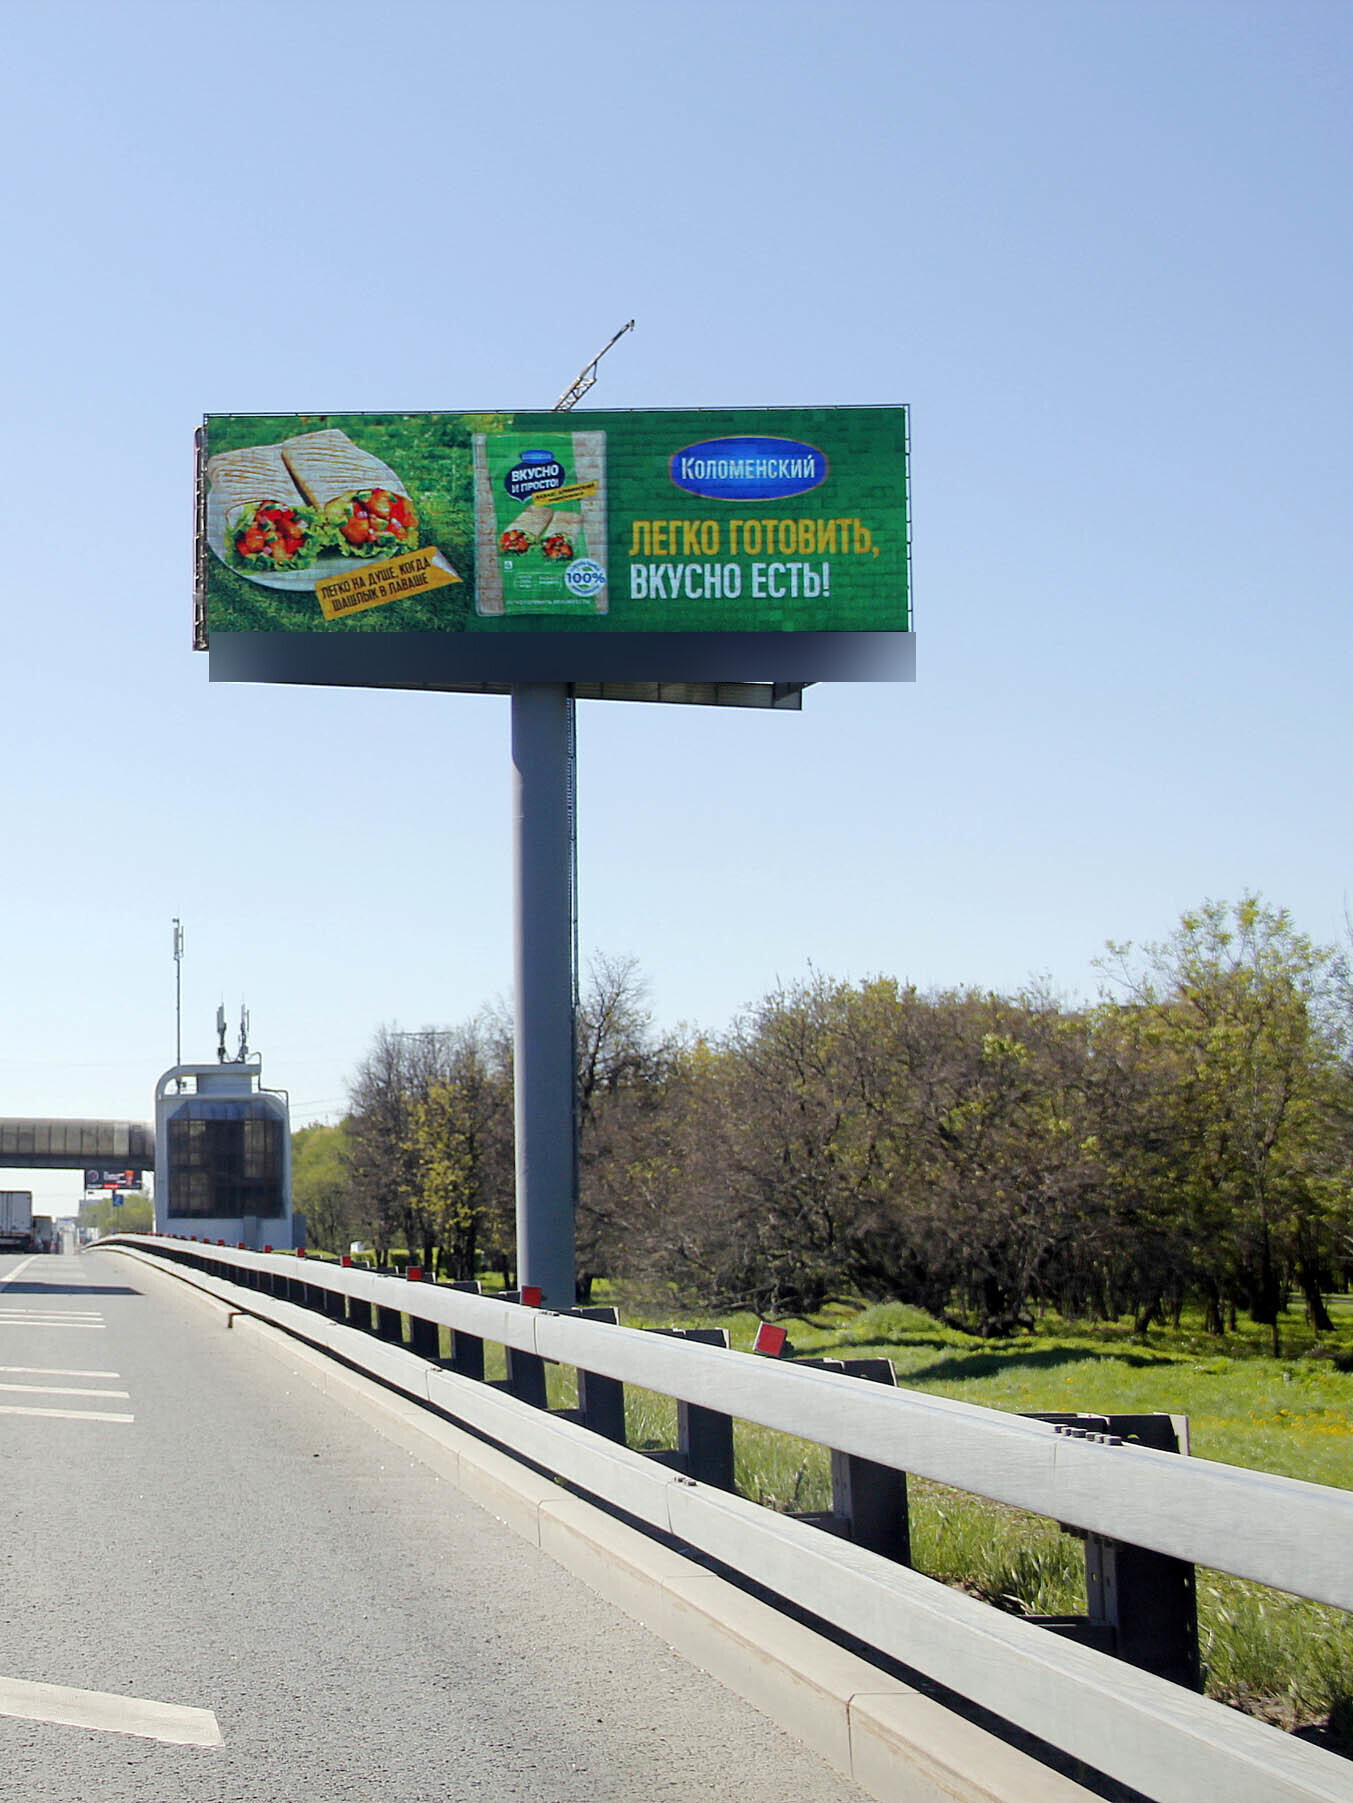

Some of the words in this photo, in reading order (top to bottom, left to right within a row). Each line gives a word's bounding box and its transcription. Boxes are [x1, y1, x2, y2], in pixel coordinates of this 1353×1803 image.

[511, 465, 559, 482] ВКУСНО
[511, 484, 520, 493] И
[629, 520, 720, 556] ЛЕГКО
[730, 519, 880, 558] ГОТОВИТЬ,
[321, 580, 350, 599] ЛЕГКО
[353, 577, 367, 591] НА
[399, 556, 431, 575] КОГДА
[332, 588, 378, 612] ШАШЛЫК
[380, 585, 388, 597] В
[389, 572, 429, 596] ЛАВАШЕ
[566, 572, 606, 584] 100%
[630, 563, 742, 599] ВКУСНО
[751, 562, 830, 598] ЕСТЬ!
